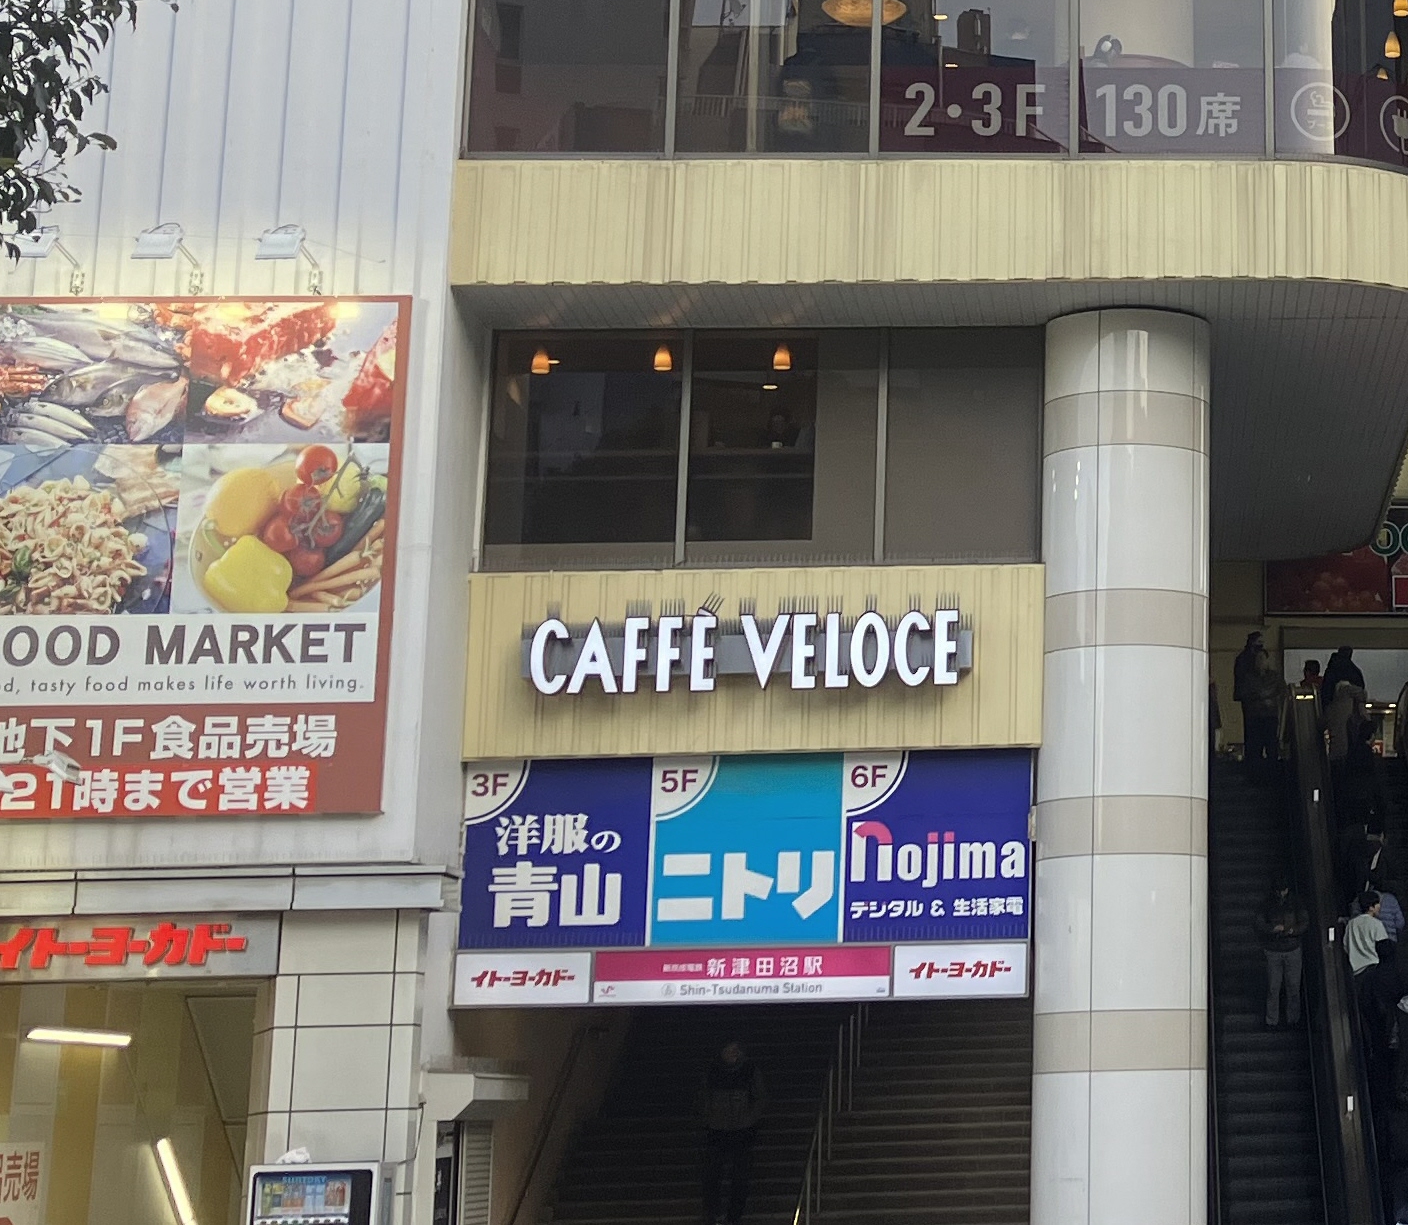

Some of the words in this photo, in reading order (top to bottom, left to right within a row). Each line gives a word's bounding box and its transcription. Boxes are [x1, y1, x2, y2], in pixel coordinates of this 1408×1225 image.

[1095, 83, 1242, 138] 130席
[2, 624, 121, 667] OOD
[144, 622, 367, 666] MARKET
[739, 608, 960, 691] VELOCE
[31, 679, 76, 697] tasty
[85, 675, 129, 692] food
[137, 677, 195, 692] makes
[204, 675, 234, 691] life
[243, 675, 297, 690] worth
[0, 765, 311, 812] 21時まで営業
[471, 773, 510, 797] 3F
[659, 768, 699, 793] 5F
[850, 764, 888, 788] 6F
[494, 813, 622, 856] 洋服の
[850, 820, 1026, 889] nojima
[487, 860, 623, 928] 青山
[656, 849, 836, 922] ニトリ
[850, 899, 924, 919] デジタル
[929, 898, 946, 918] &
[952, 895, 1024, 918] 生活家電
[0, 922, 248, 970] イトーヨーカドー
[706, 955, 823, 978] 新津田沼駅
[470, 968, 576, 988] イトーヨーカドー
[679, 983, 780, 996] Shin-Tsudanuma
[782, 981, 823, 994] Station
[908, 960, 1012, 980] イトーヨーカドー
[0, 1149, 41, 1204] 売場
